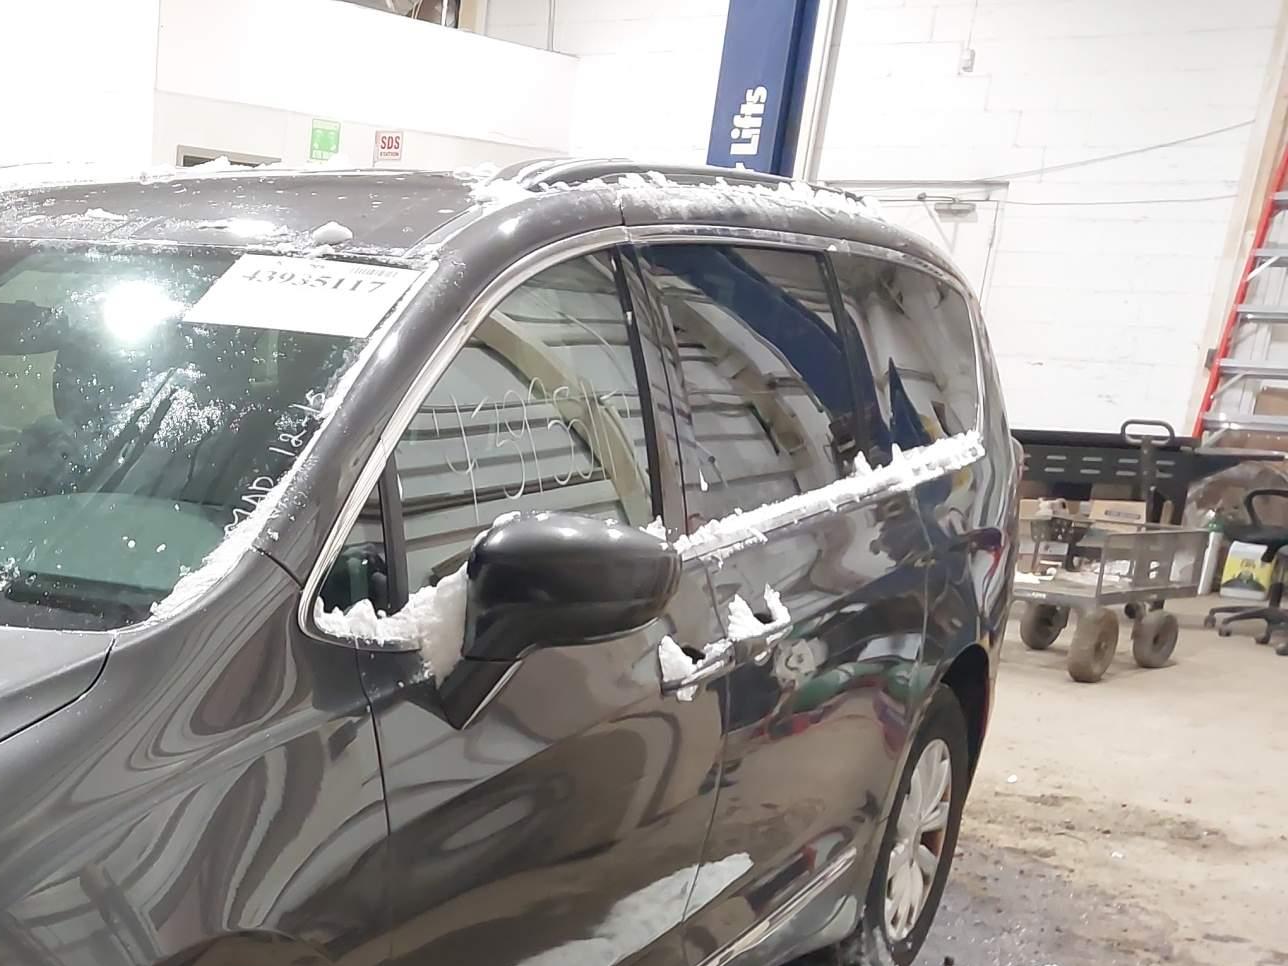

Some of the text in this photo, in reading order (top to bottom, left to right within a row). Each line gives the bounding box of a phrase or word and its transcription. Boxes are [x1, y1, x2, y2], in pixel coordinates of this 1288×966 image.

[729, 86, 768, 155] Lifts
[380, 135, 400, 149] SDS
[242, 269, 387, 294] 43935117
